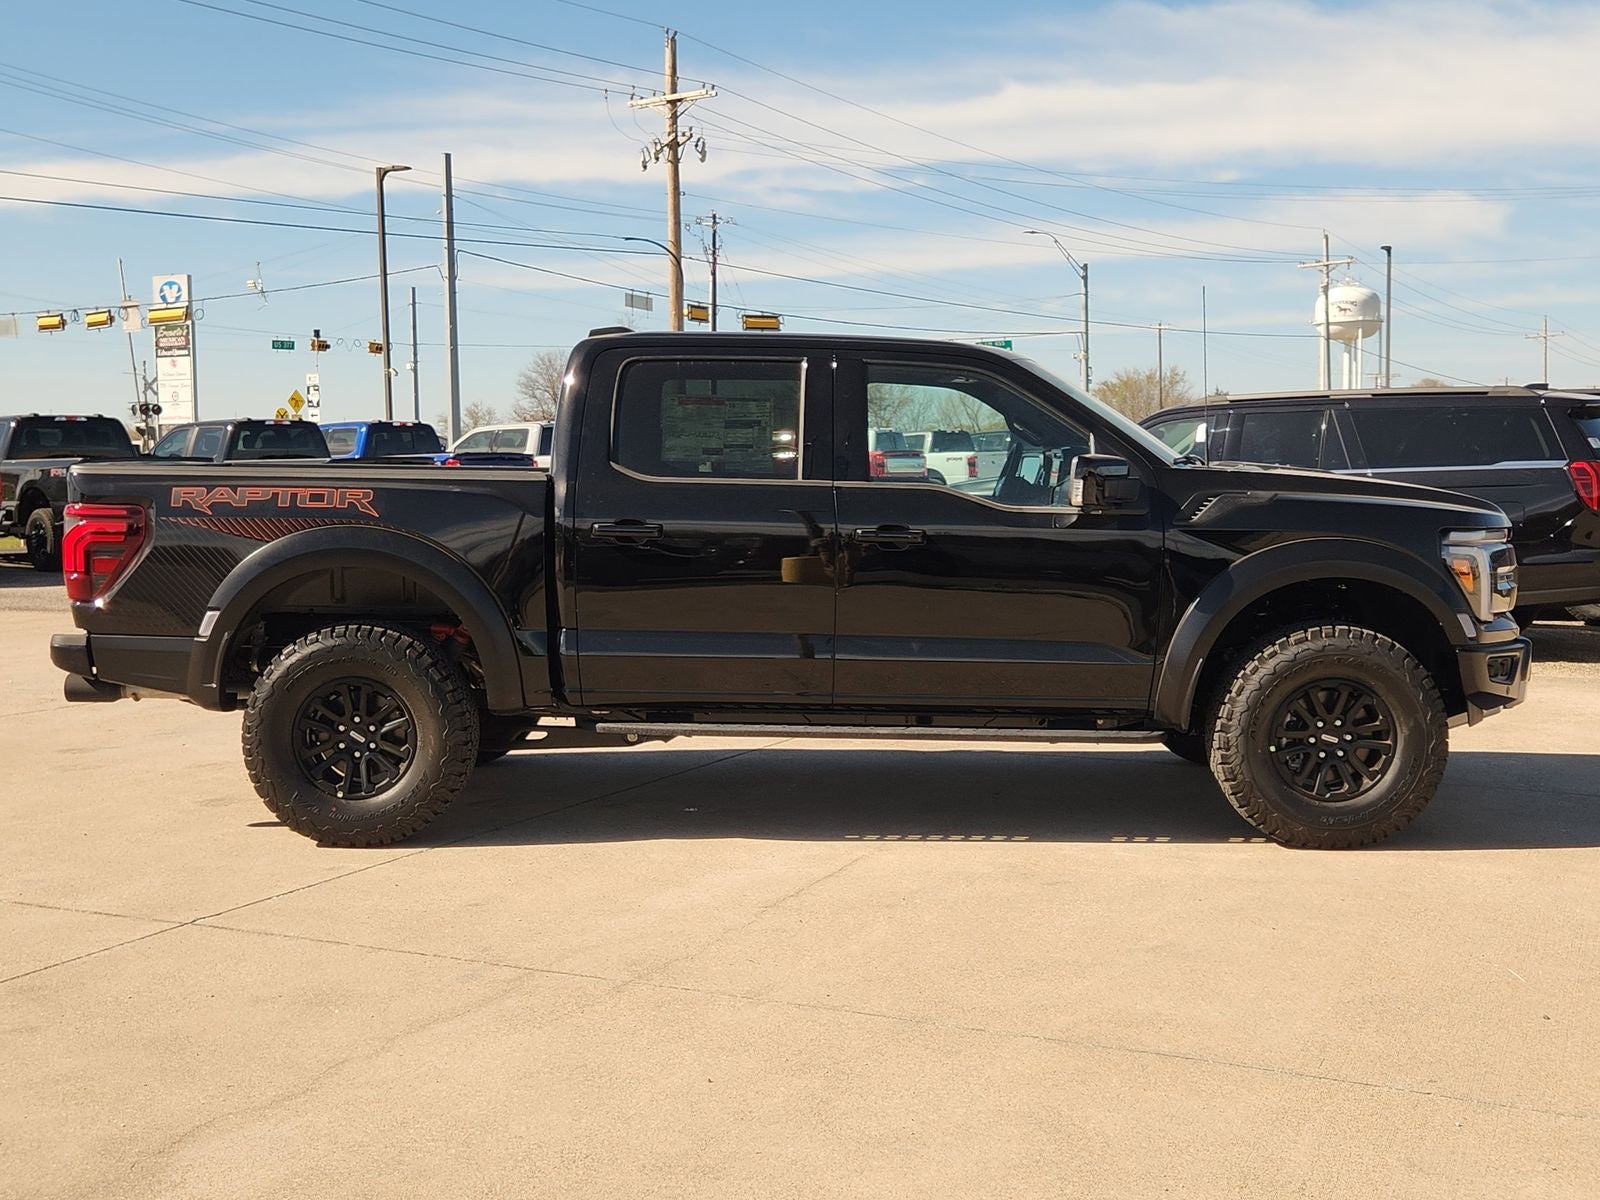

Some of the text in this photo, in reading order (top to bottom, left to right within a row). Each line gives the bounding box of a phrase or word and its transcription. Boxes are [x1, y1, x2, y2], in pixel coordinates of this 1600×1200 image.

[274, 341, 293, 349] US 377
[171, 487, 380, 518] RAPTOR
